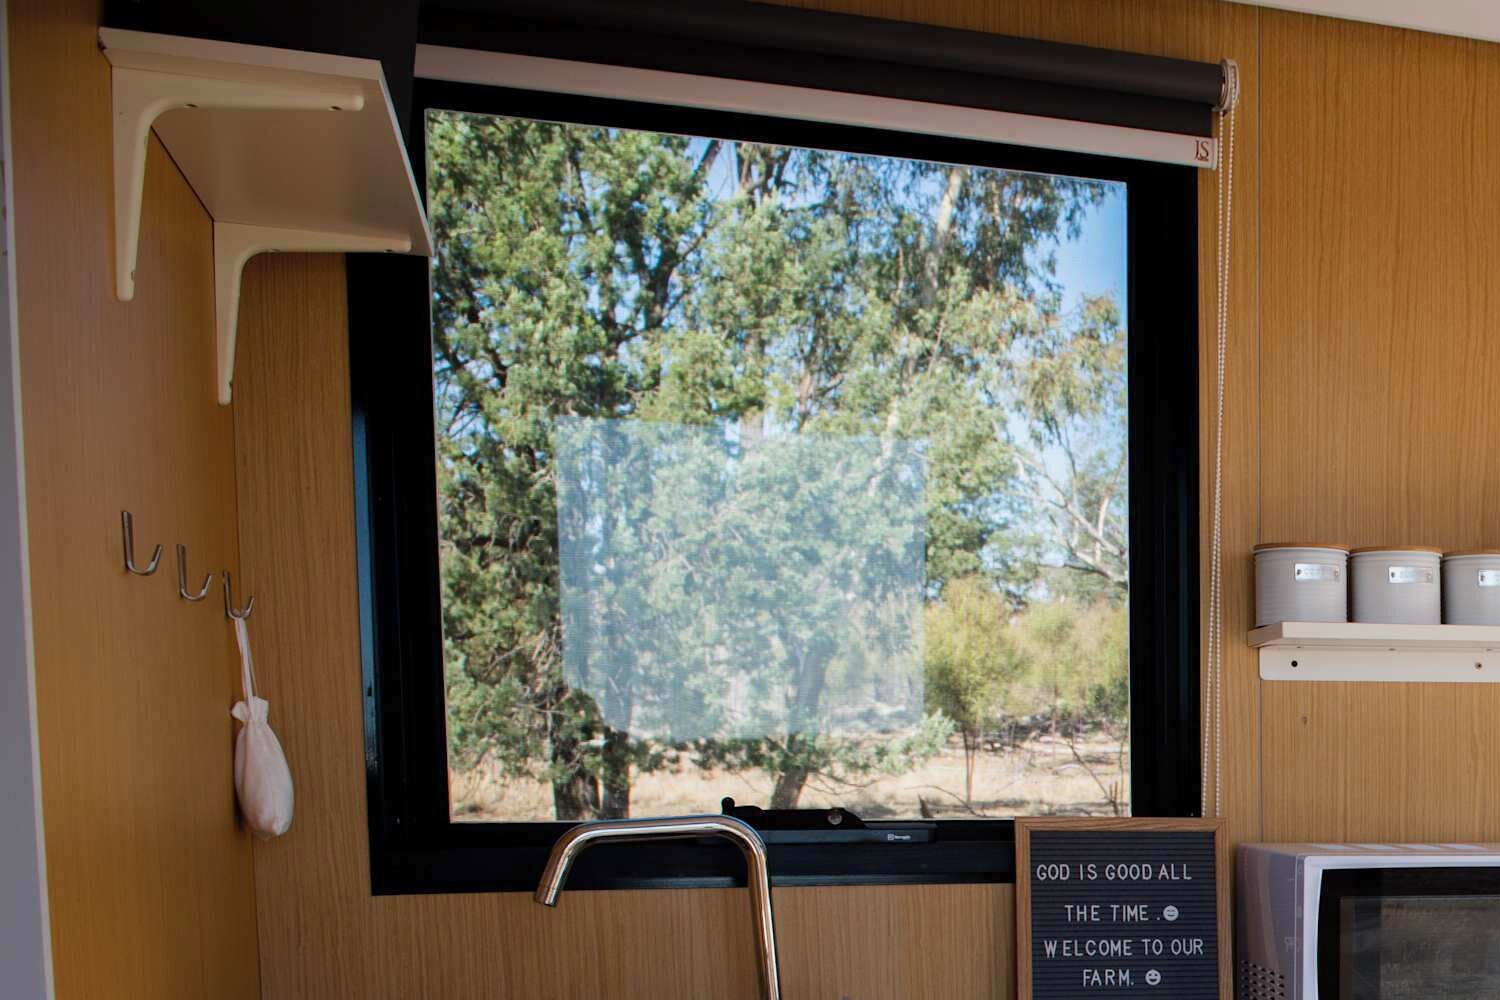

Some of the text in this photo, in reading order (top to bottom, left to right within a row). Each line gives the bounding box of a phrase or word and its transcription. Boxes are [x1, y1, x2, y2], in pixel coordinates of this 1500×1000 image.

[1036, 863, 1193, 881] GOD IS GOOD ALL
[1064, 904, 1100, 922] THE
[1044, 938, 1204, 959] WELCOME TO OUR
[1082, 969, 1135, 987] FARM.
